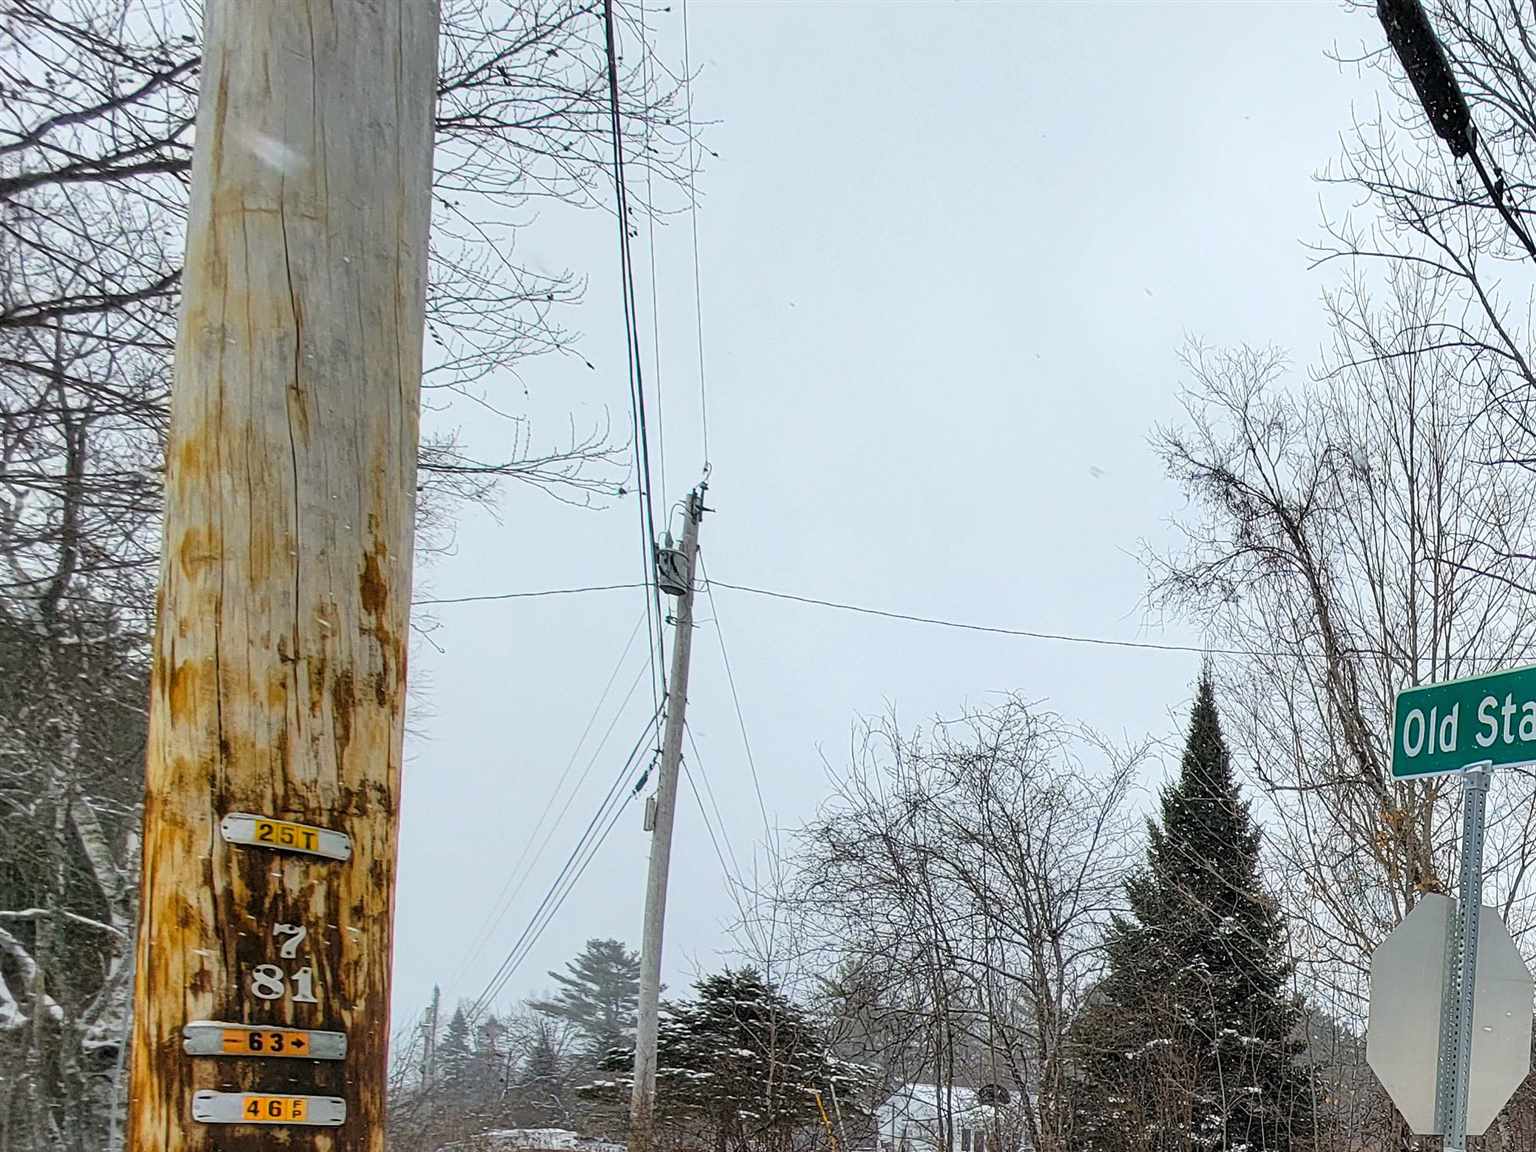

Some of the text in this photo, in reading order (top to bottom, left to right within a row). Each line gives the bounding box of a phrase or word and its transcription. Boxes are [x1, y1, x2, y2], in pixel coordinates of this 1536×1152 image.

[1403, 702, 1458, 758] Old
[258, 823, 318, 850] 25T
[273, 923, 307, 960] 7
[251, 963, 319, 1003] 81
